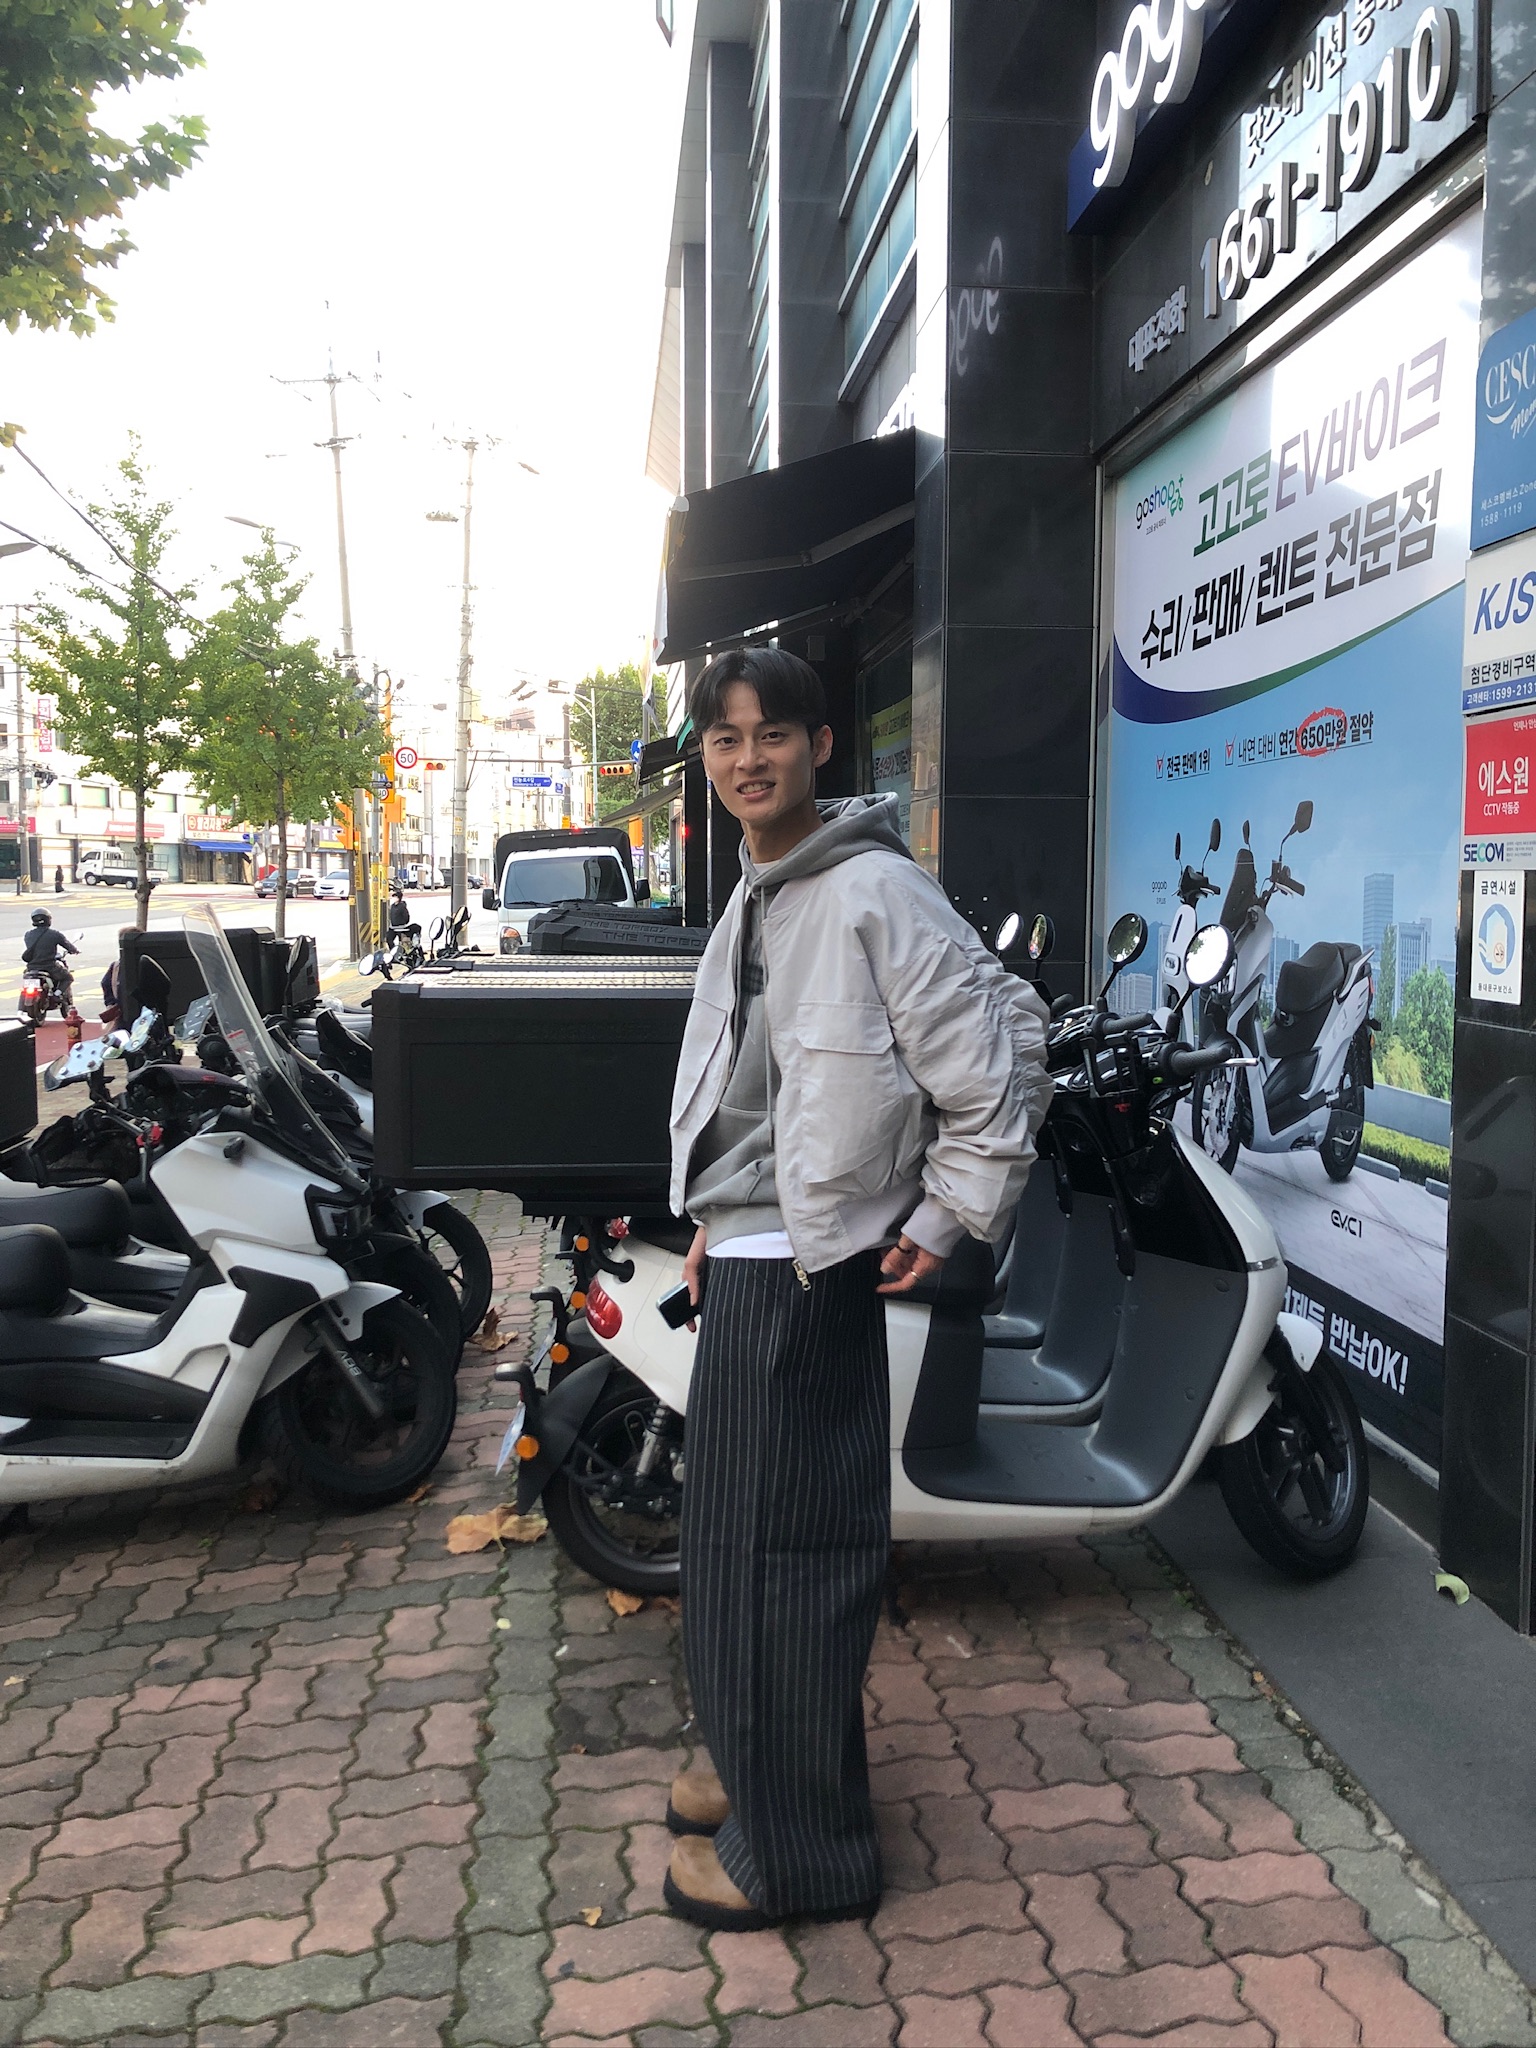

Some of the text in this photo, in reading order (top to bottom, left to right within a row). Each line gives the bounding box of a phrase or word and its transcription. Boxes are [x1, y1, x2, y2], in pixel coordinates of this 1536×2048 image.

[1090, 0, 1205, 187] gog
[1199, 6, 1460, 319] 1661-1910
[1128, 285, 1187, 372] 대표전화
[1193, 338, 1447, 556] 고고로 EV바이크
[1140, 468, 1442, 669] 수리/판매/렌트 전문점
[1471, 654, 1535, 685] 첨단경비구역
[1238, 711, 1374, 762] 내연 대비 연간 650만원 절약
[400, 753, 413, 764] 50
[1167, 748, 1210, 778] 전국 판매 1위
[1478, 756, 1529, 797] 에스원
[1483, 801, 1520, 816] CCTV 작동중
[1463, 842, 1504, 863] SECOM
[1481, 880, 1516, 896] 금연시설
[582, 919, 669, 934] THE TOPBOX
[602, 931, 639, 942] THE
[1477, 982, 1513, 995] 동대문구보건소
[1329, 1312, 1409, 1396] 반납OK!
